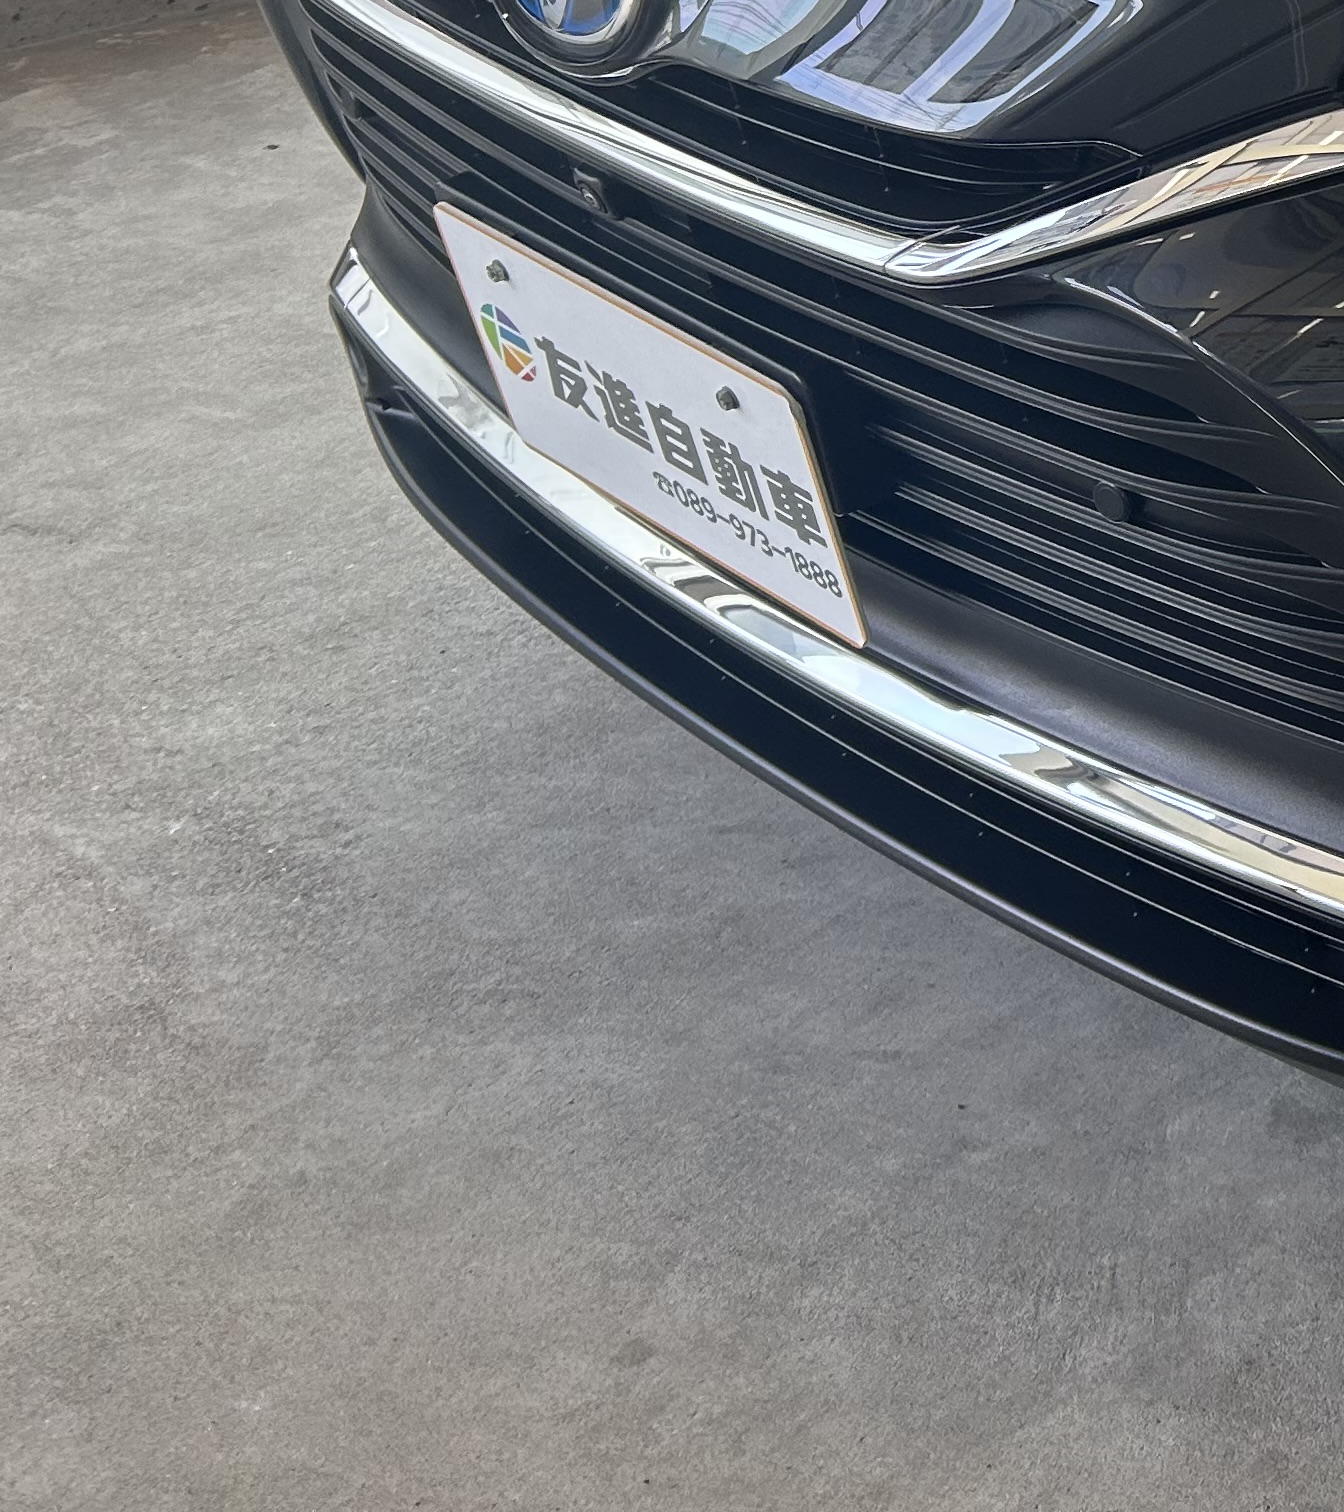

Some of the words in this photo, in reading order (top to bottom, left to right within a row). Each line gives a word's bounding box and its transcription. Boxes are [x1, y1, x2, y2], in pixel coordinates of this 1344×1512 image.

[534, 335, 829, 549] 友進自動車
